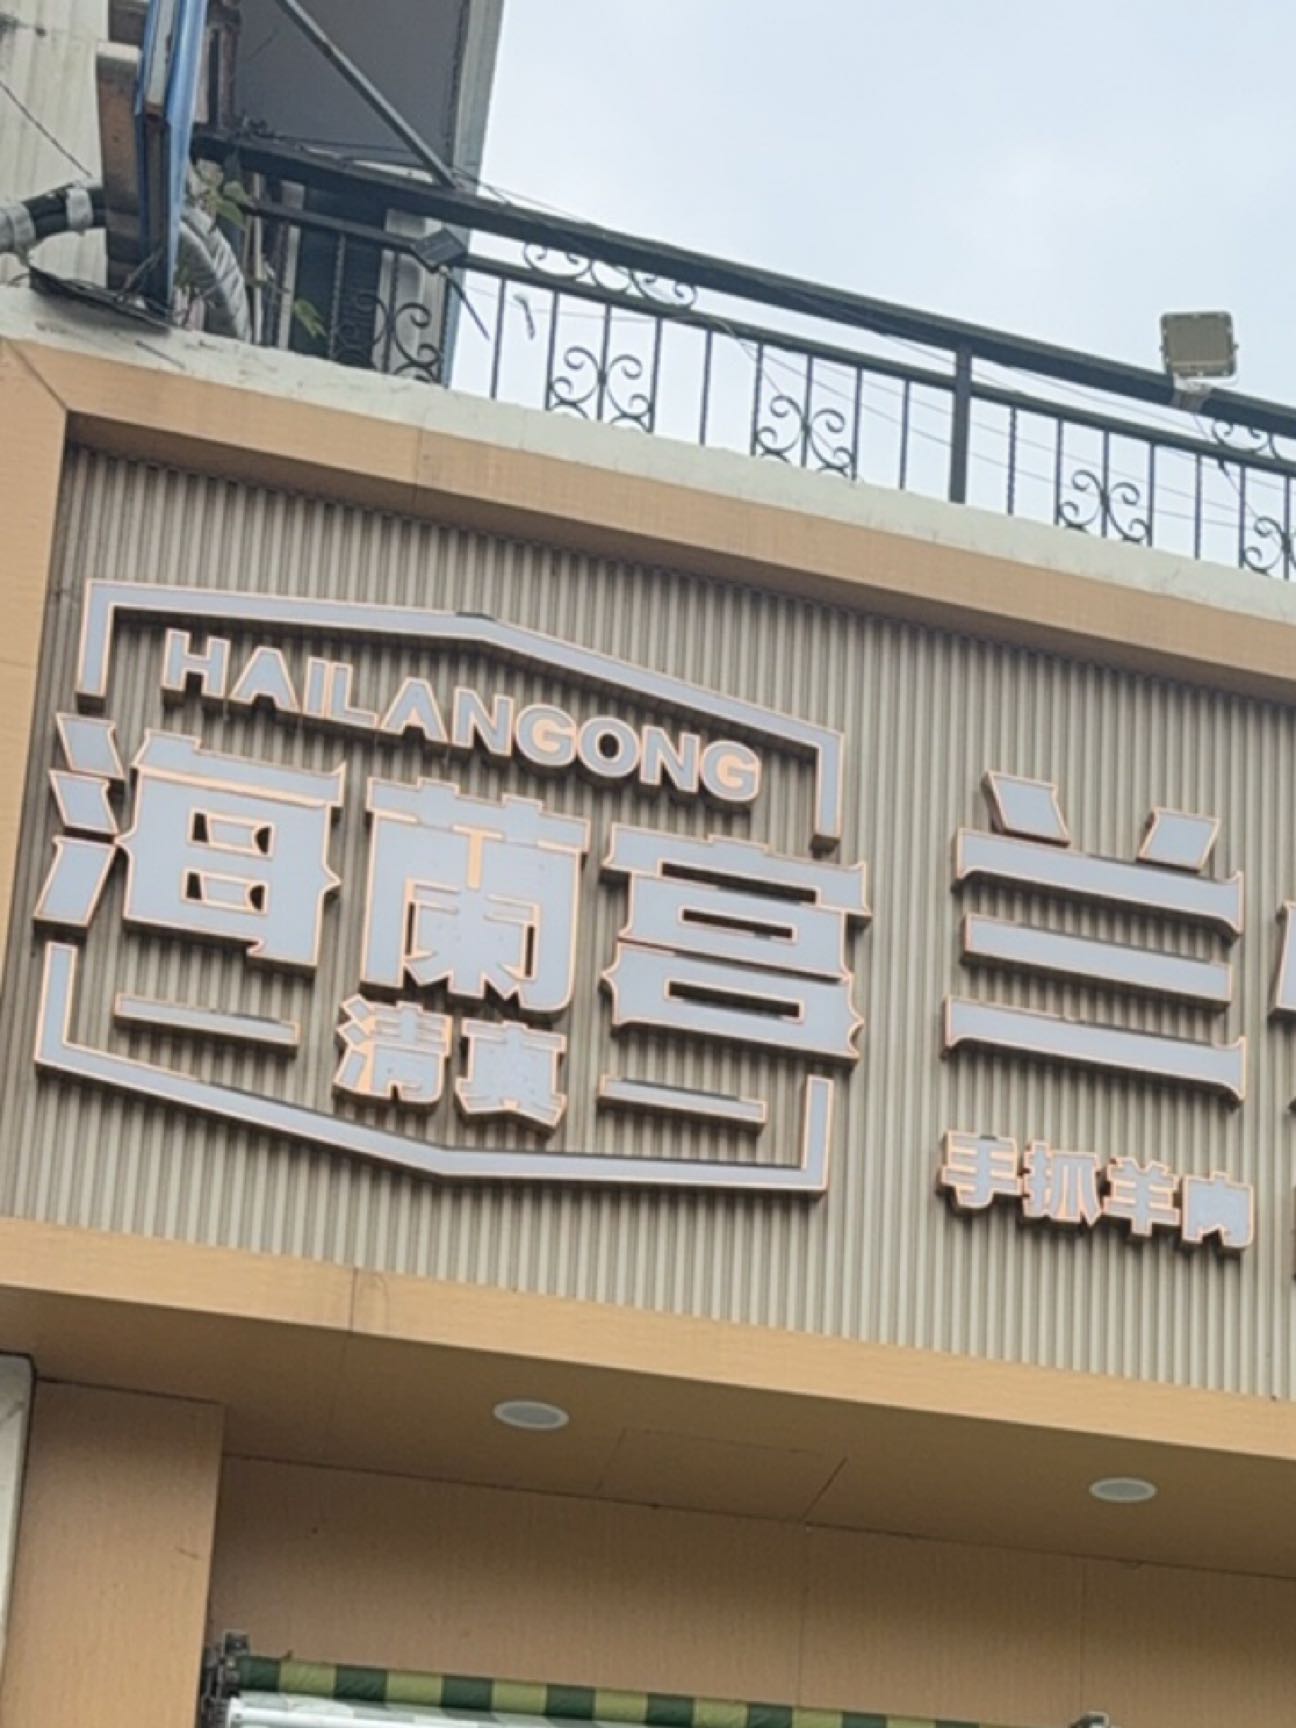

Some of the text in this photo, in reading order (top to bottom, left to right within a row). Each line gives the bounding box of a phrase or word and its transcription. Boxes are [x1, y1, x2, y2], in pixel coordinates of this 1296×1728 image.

[162, 629, 763, 803] HAILANGONG
[333, 993, 568, 1127] 清真
[941, 1130, 1254, 1249] 手抓羊肉
